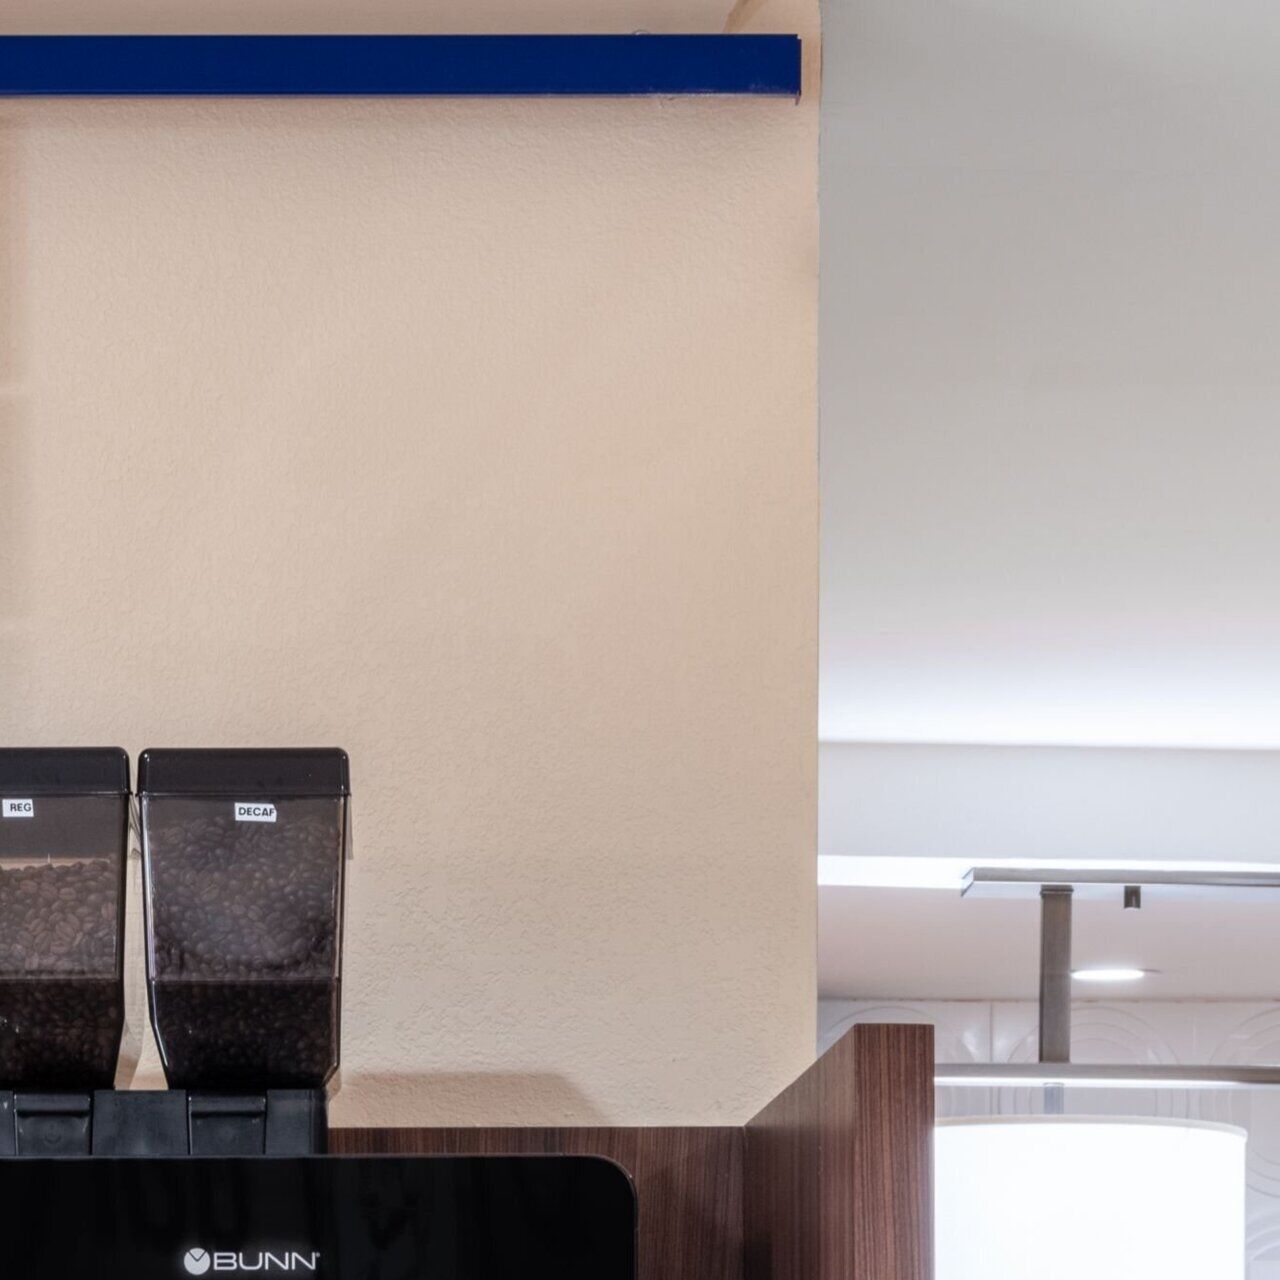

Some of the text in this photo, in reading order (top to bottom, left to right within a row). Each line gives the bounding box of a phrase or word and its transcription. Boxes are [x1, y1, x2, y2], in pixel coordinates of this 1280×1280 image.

[9, 802, 32, 813] REG
[237, 806, 276, 817] DECAF
[213, 1251, 317, 1271] BUNN
